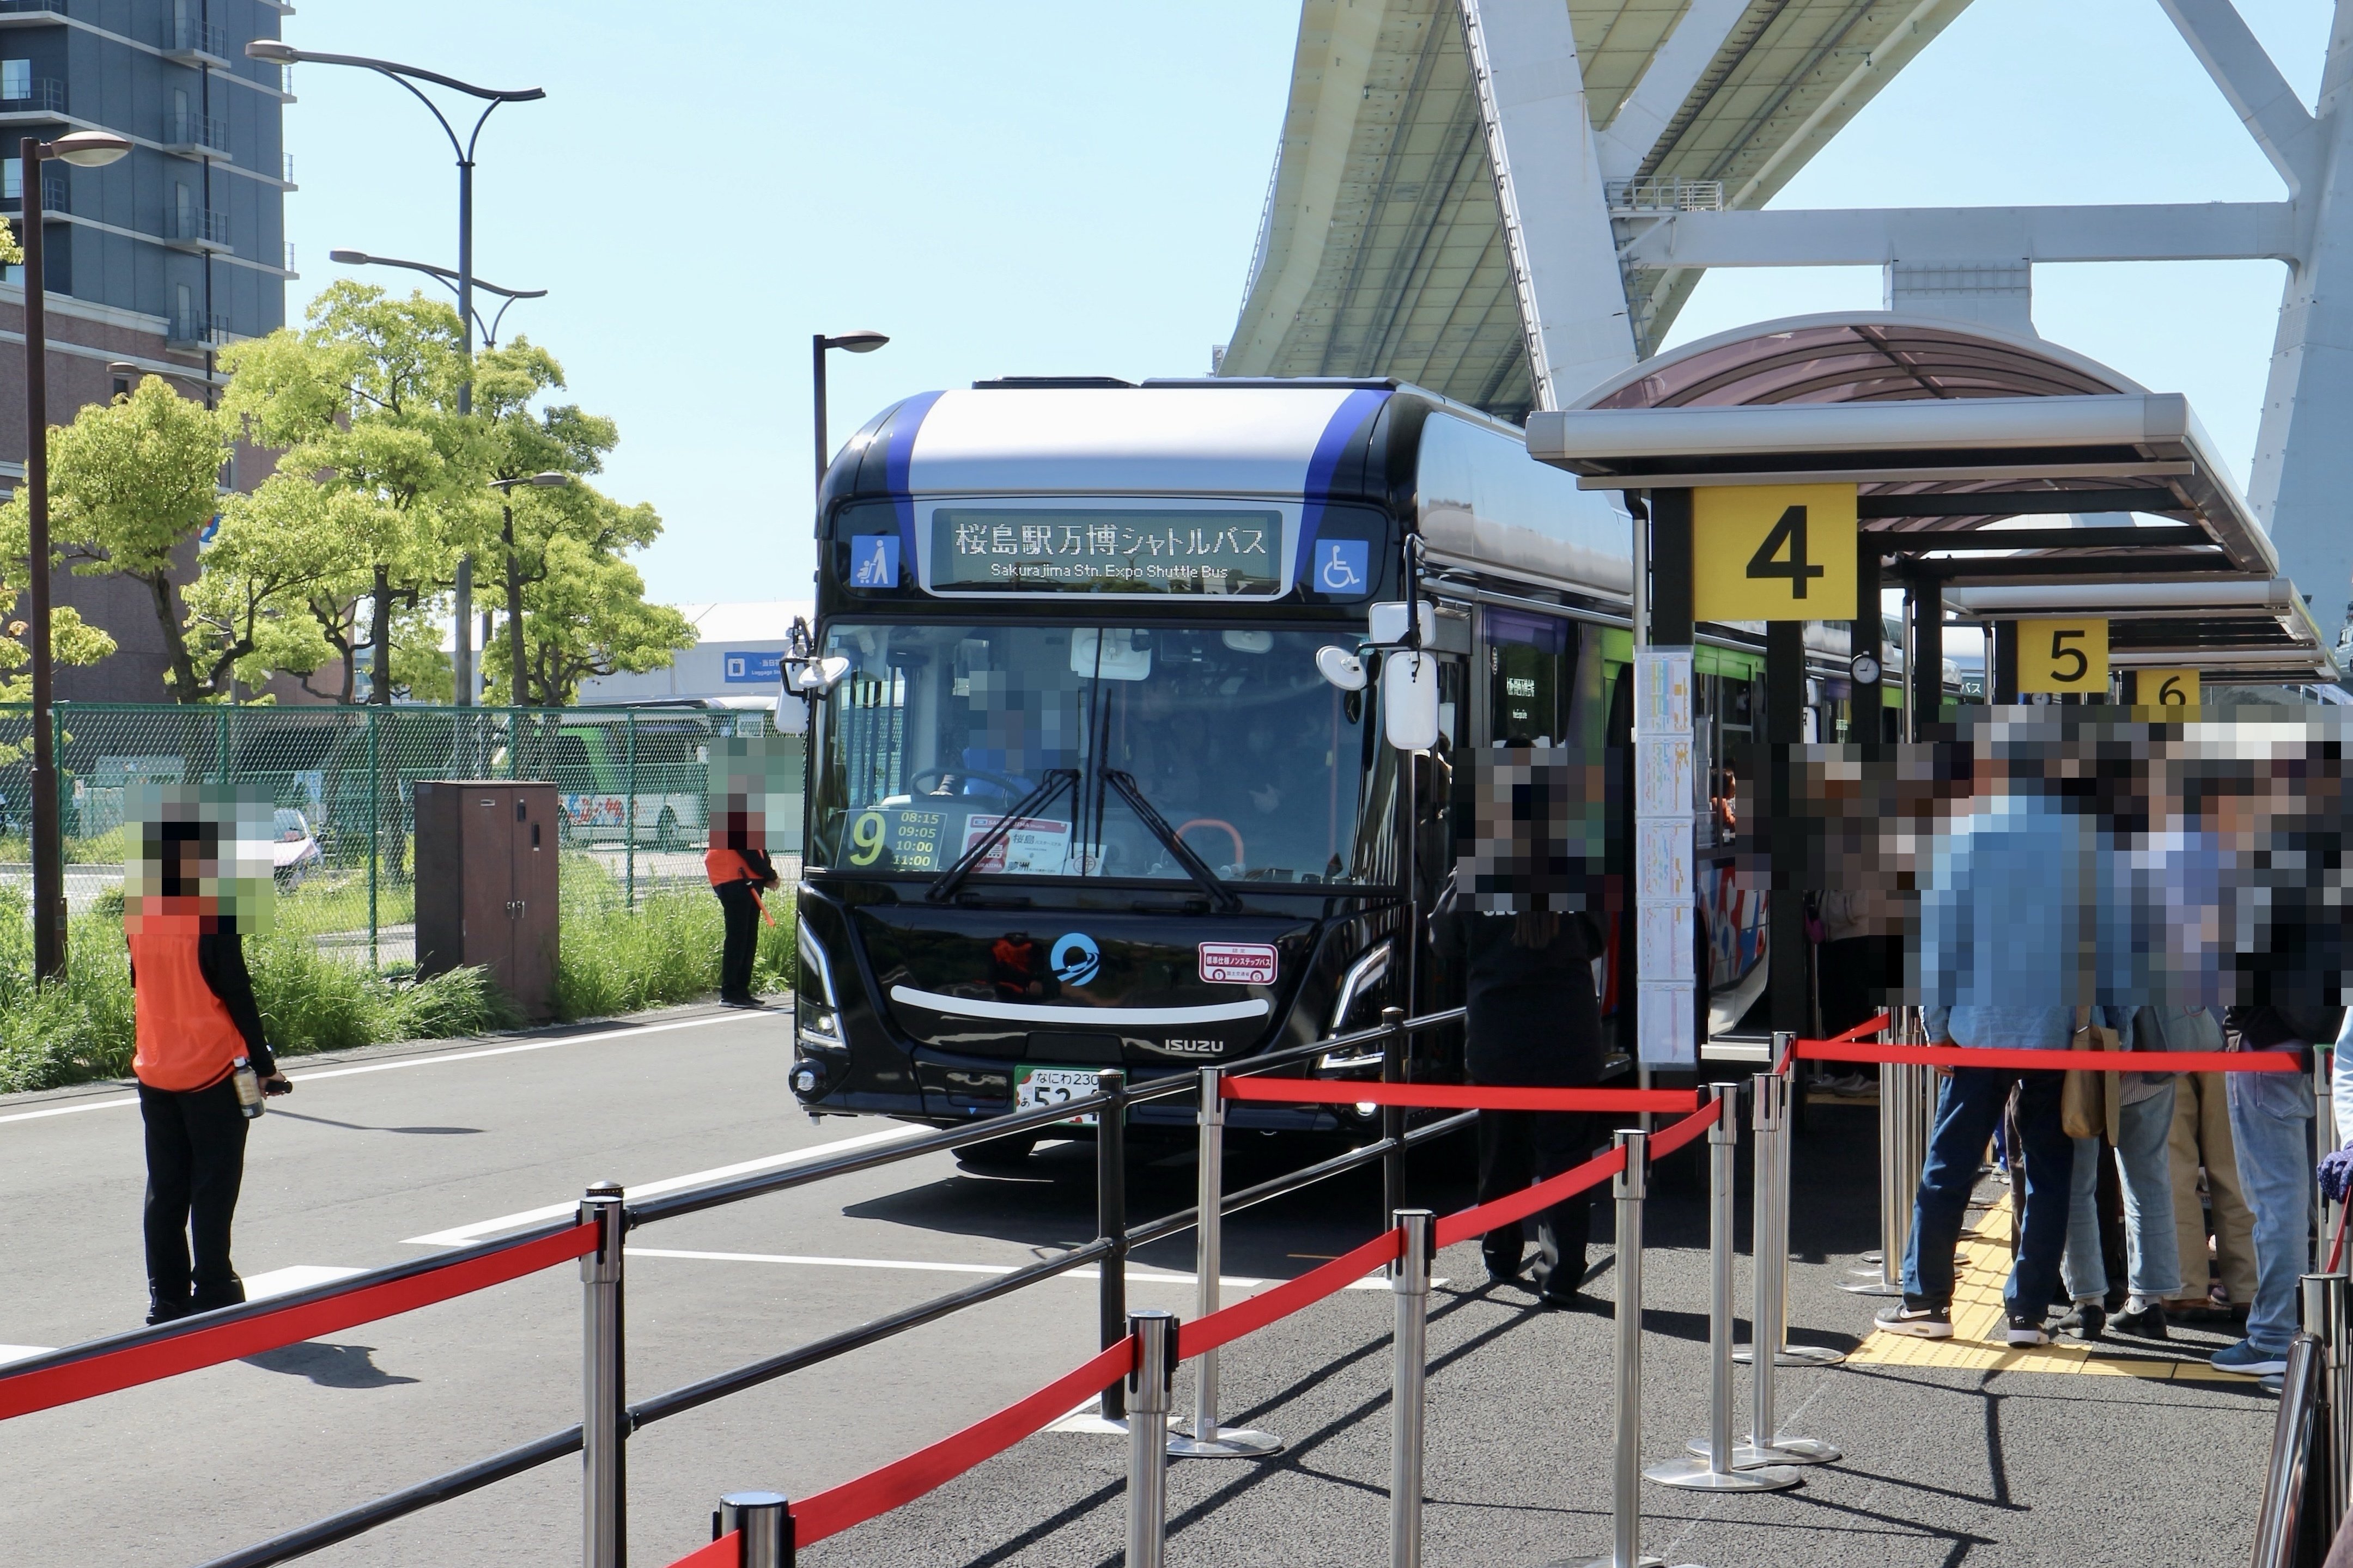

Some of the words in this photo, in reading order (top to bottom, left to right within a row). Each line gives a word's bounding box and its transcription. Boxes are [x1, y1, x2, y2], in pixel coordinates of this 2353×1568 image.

[956, 523, 1267, 556] 桜島駅万博シャトルバス
[1746, 505, 1824, 599] 4
[990, 563, 1071, 578] Sakurajima
[1074, 564, 1102, 577] Stn.
[1105, 564, 1143, 581] Expo
[1147, 565, 1198, 578] Shuttle
[1201, 565, 1228, 578] Bus
[2050, 630, 2088, 682] 5
[2159, 676, 2186, 705] 6
[901, 812, 940, 824] 08:15
[898, 826, 937, 838] 09:05
[850, 812, 886, 866] 9
[896, 840, 933, 852] 10:00
[893, 855, 931, 867] 11:00
[1206, 955, 1270, 966] 標準仕様ノンステップバス
[1165, 1039, 1224, 1052] ISUZU
[1020, 1097, 1030, 1107] あ
